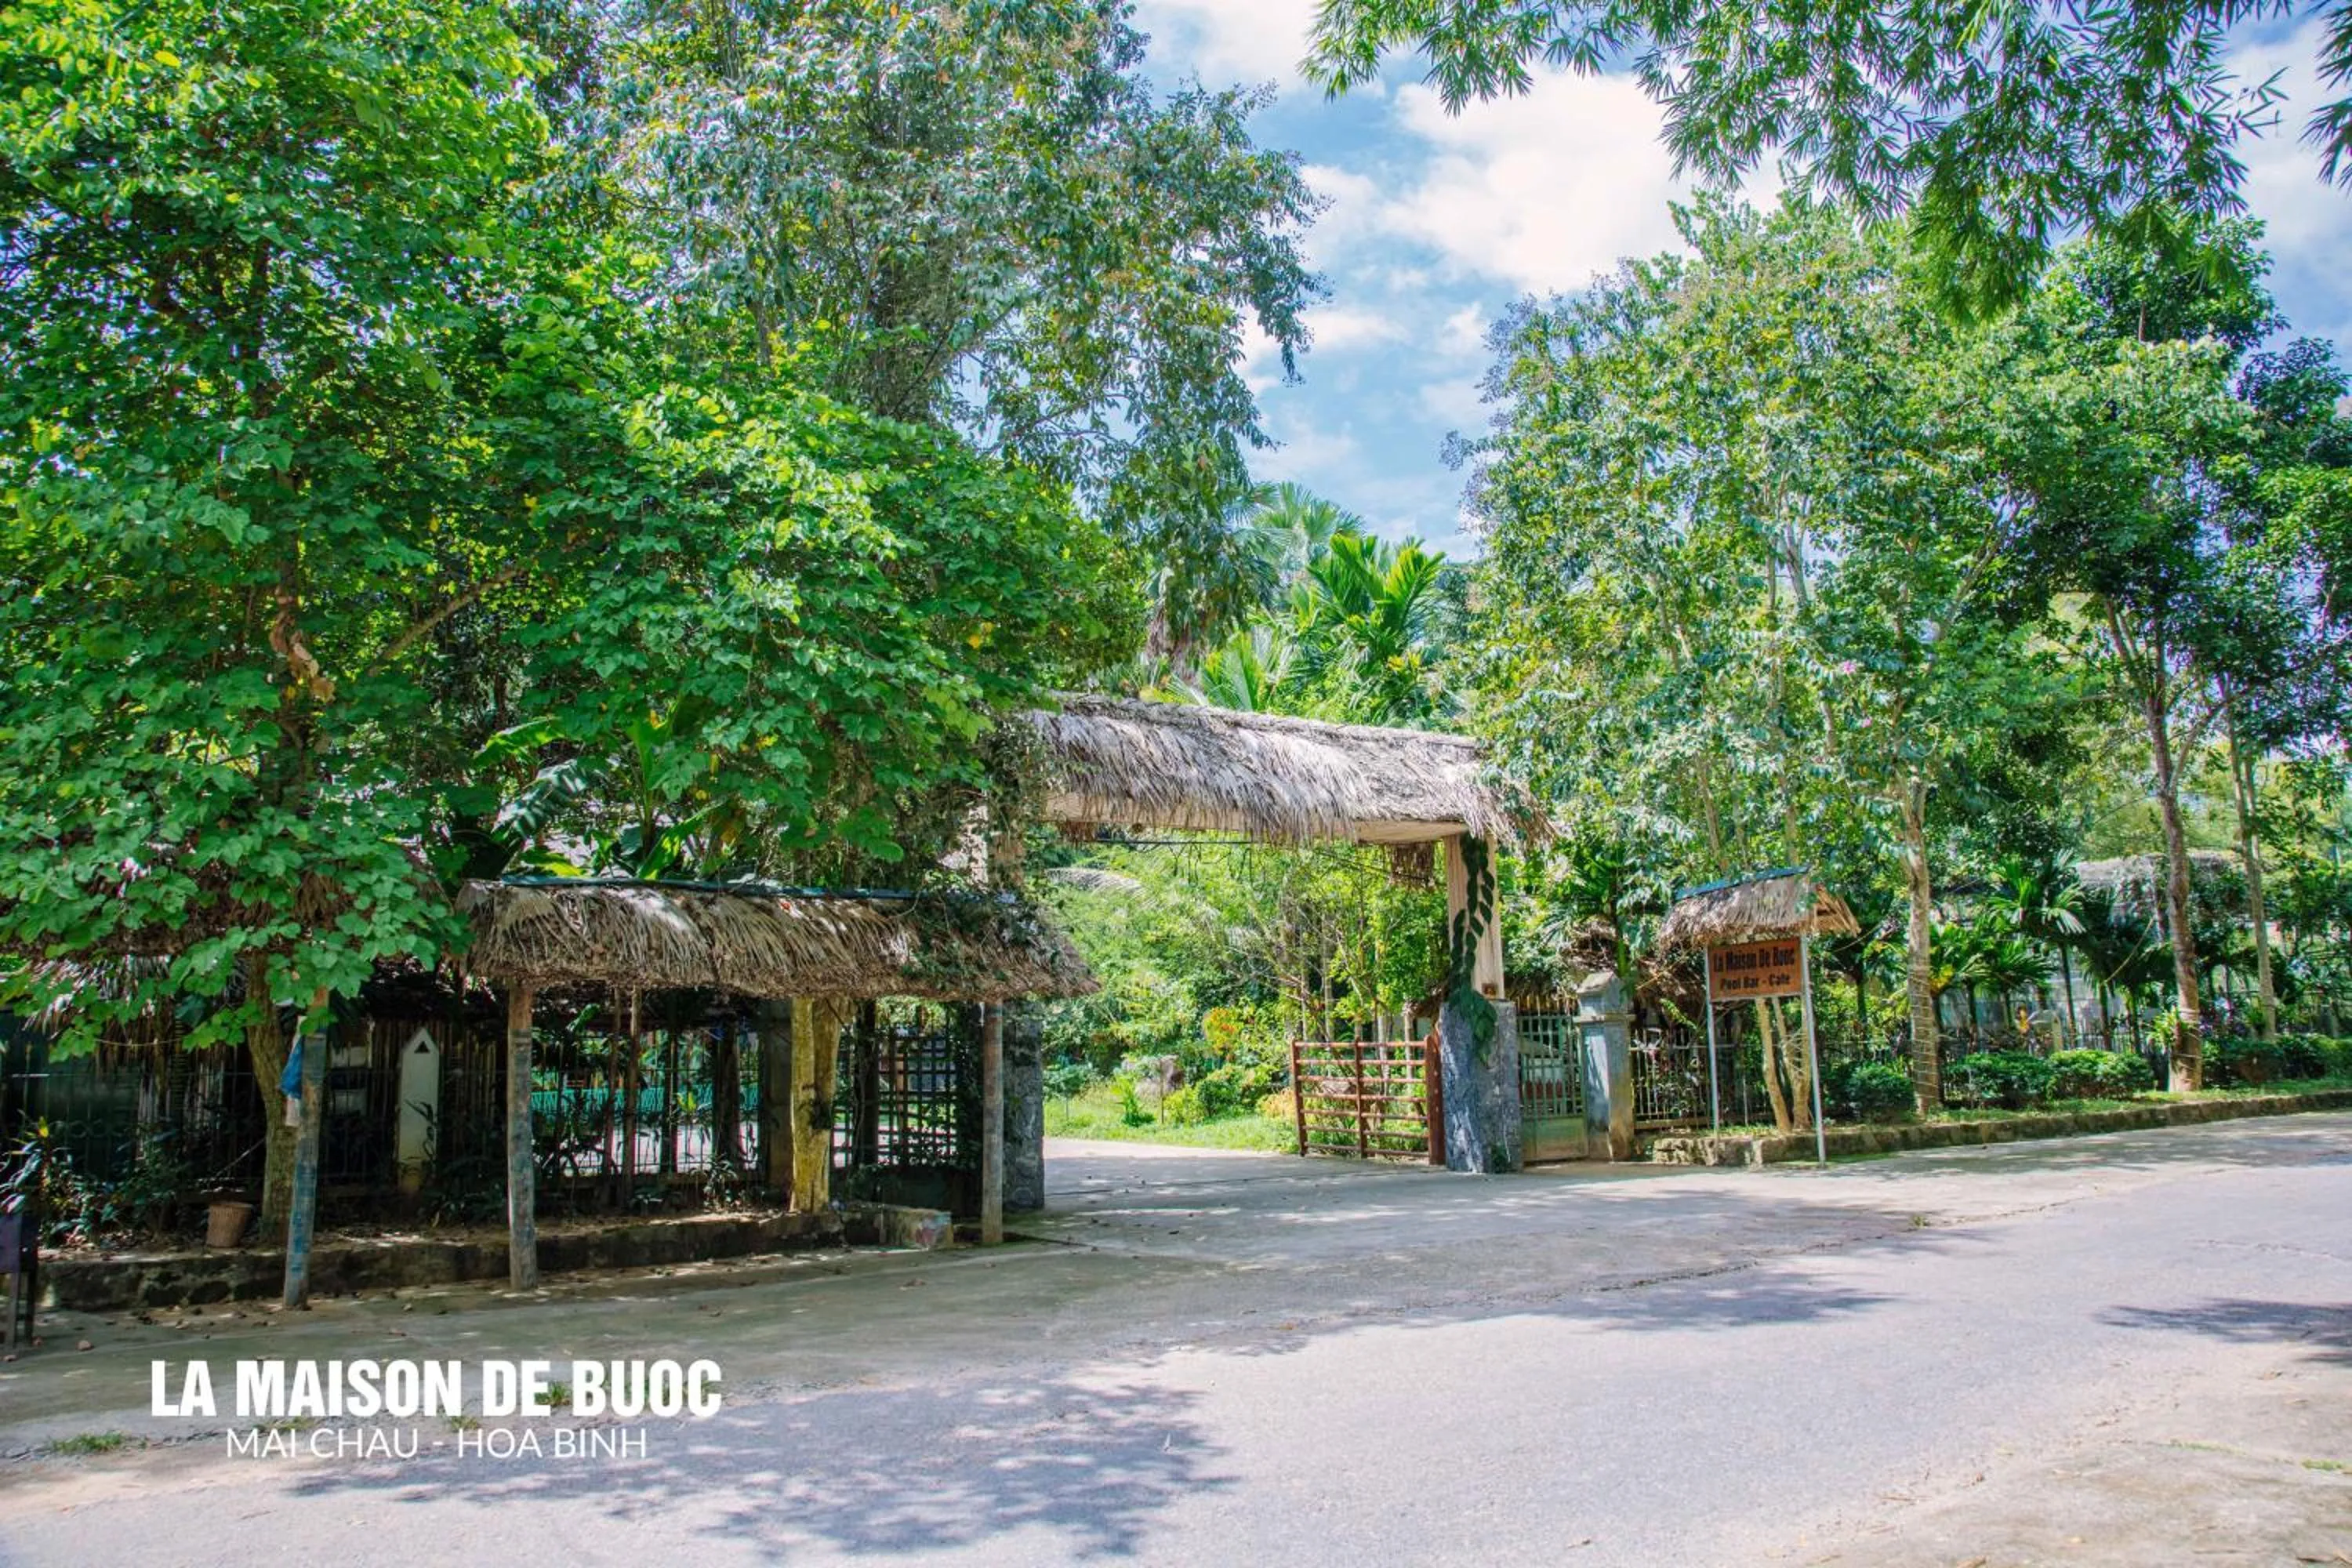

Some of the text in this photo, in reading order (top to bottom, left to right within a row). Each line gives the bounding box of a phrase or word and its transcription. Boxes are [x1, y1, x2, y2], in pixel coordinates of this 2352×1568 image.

[1726, 949, 1756, 971] Maison
[1759, 948, 1770, 968] De
[1743, 976, 1758, 988] Bar
